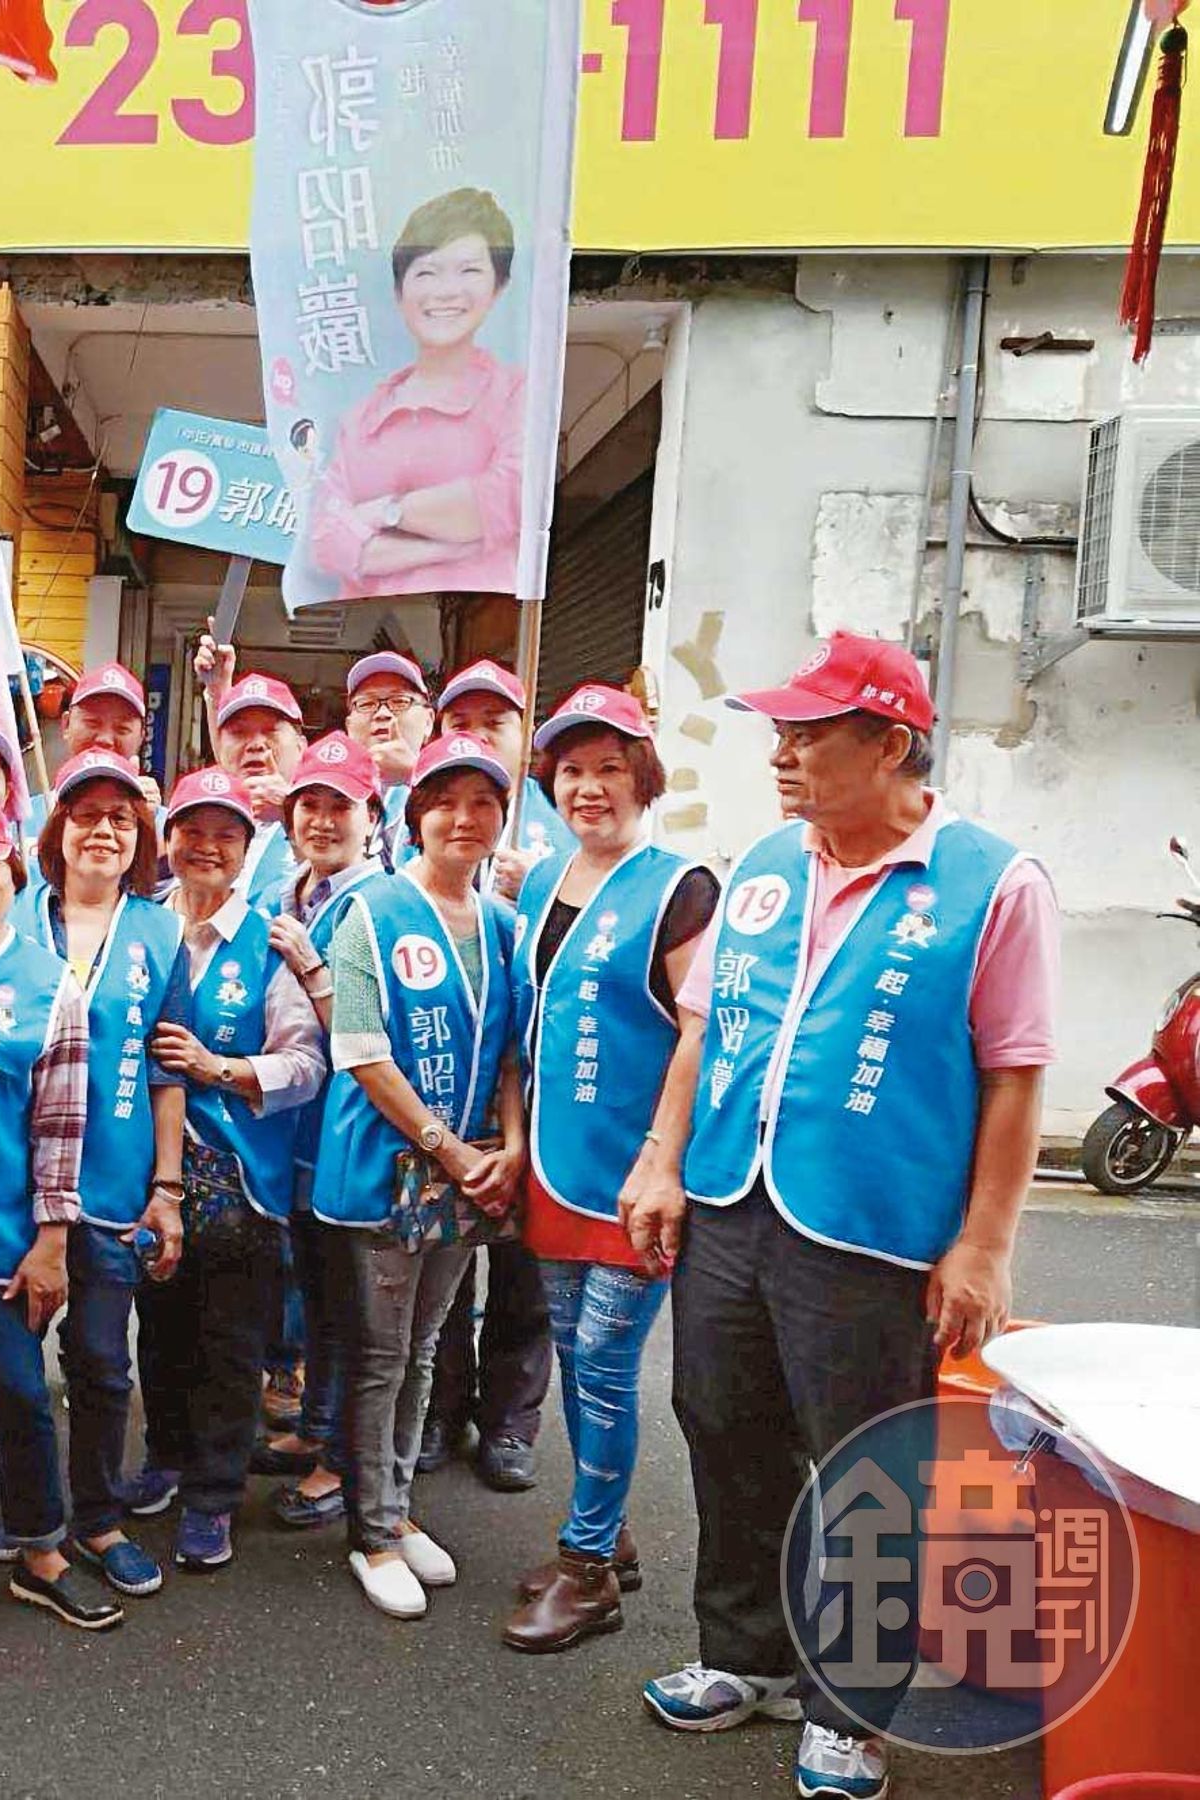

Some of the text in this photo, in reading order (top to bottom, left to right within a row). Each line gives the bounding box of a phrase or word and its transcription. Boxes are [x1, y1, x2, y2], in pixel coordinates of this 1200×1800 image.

[157, 461, 214, 515] 19
[737, 885, 782, 924] 19
[396, 945, 439, 988] 19
